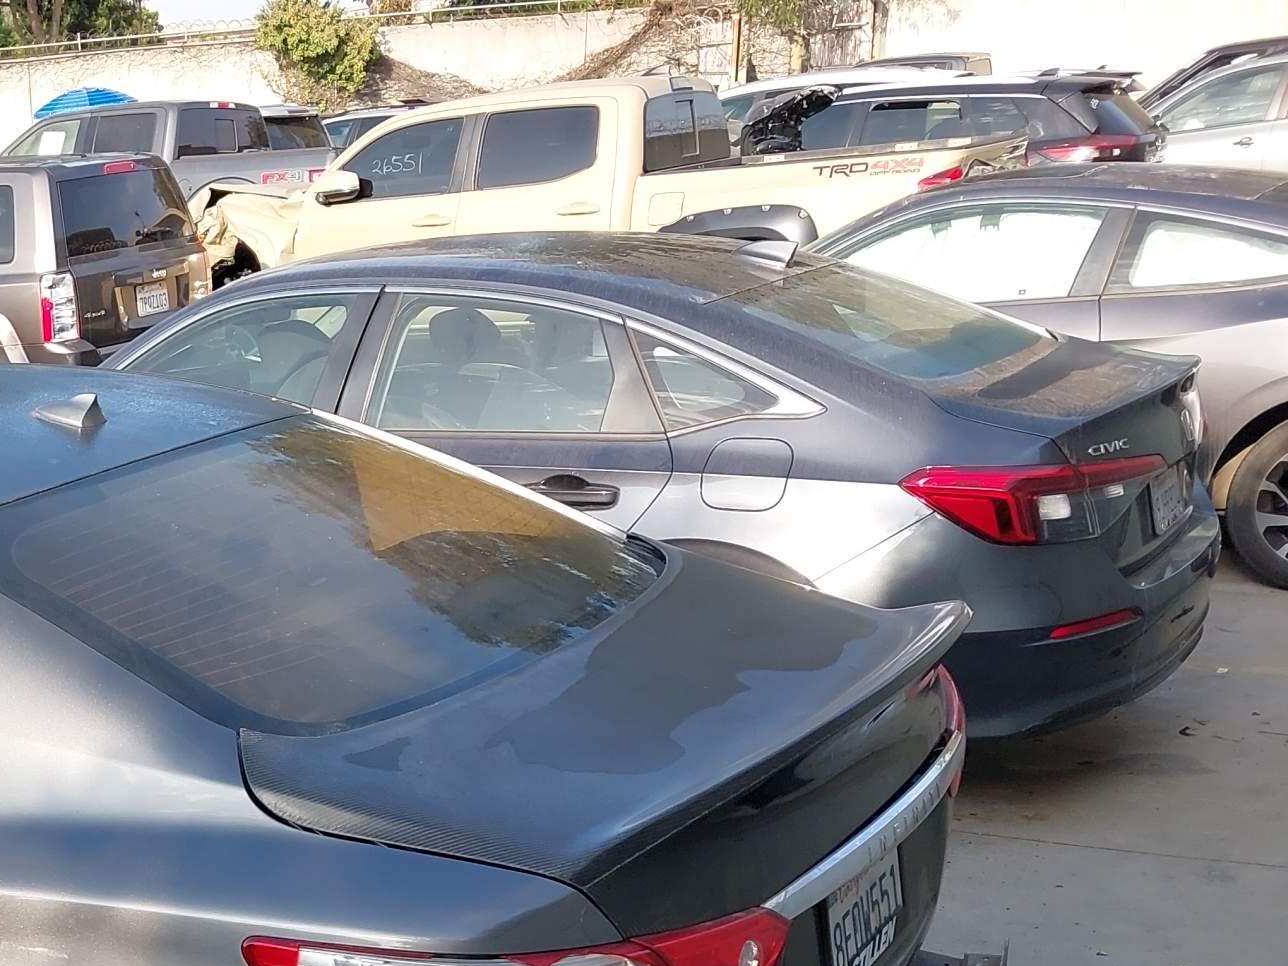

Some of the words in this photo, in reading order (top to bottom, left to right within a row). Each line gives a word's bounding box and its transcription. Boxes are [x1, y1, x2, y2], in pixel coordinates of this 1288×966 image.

[371, 152, 423, 175] 26551
[813, 162, 868, 178] TRD
[1087, 438, 1130, 456] CIVIC
